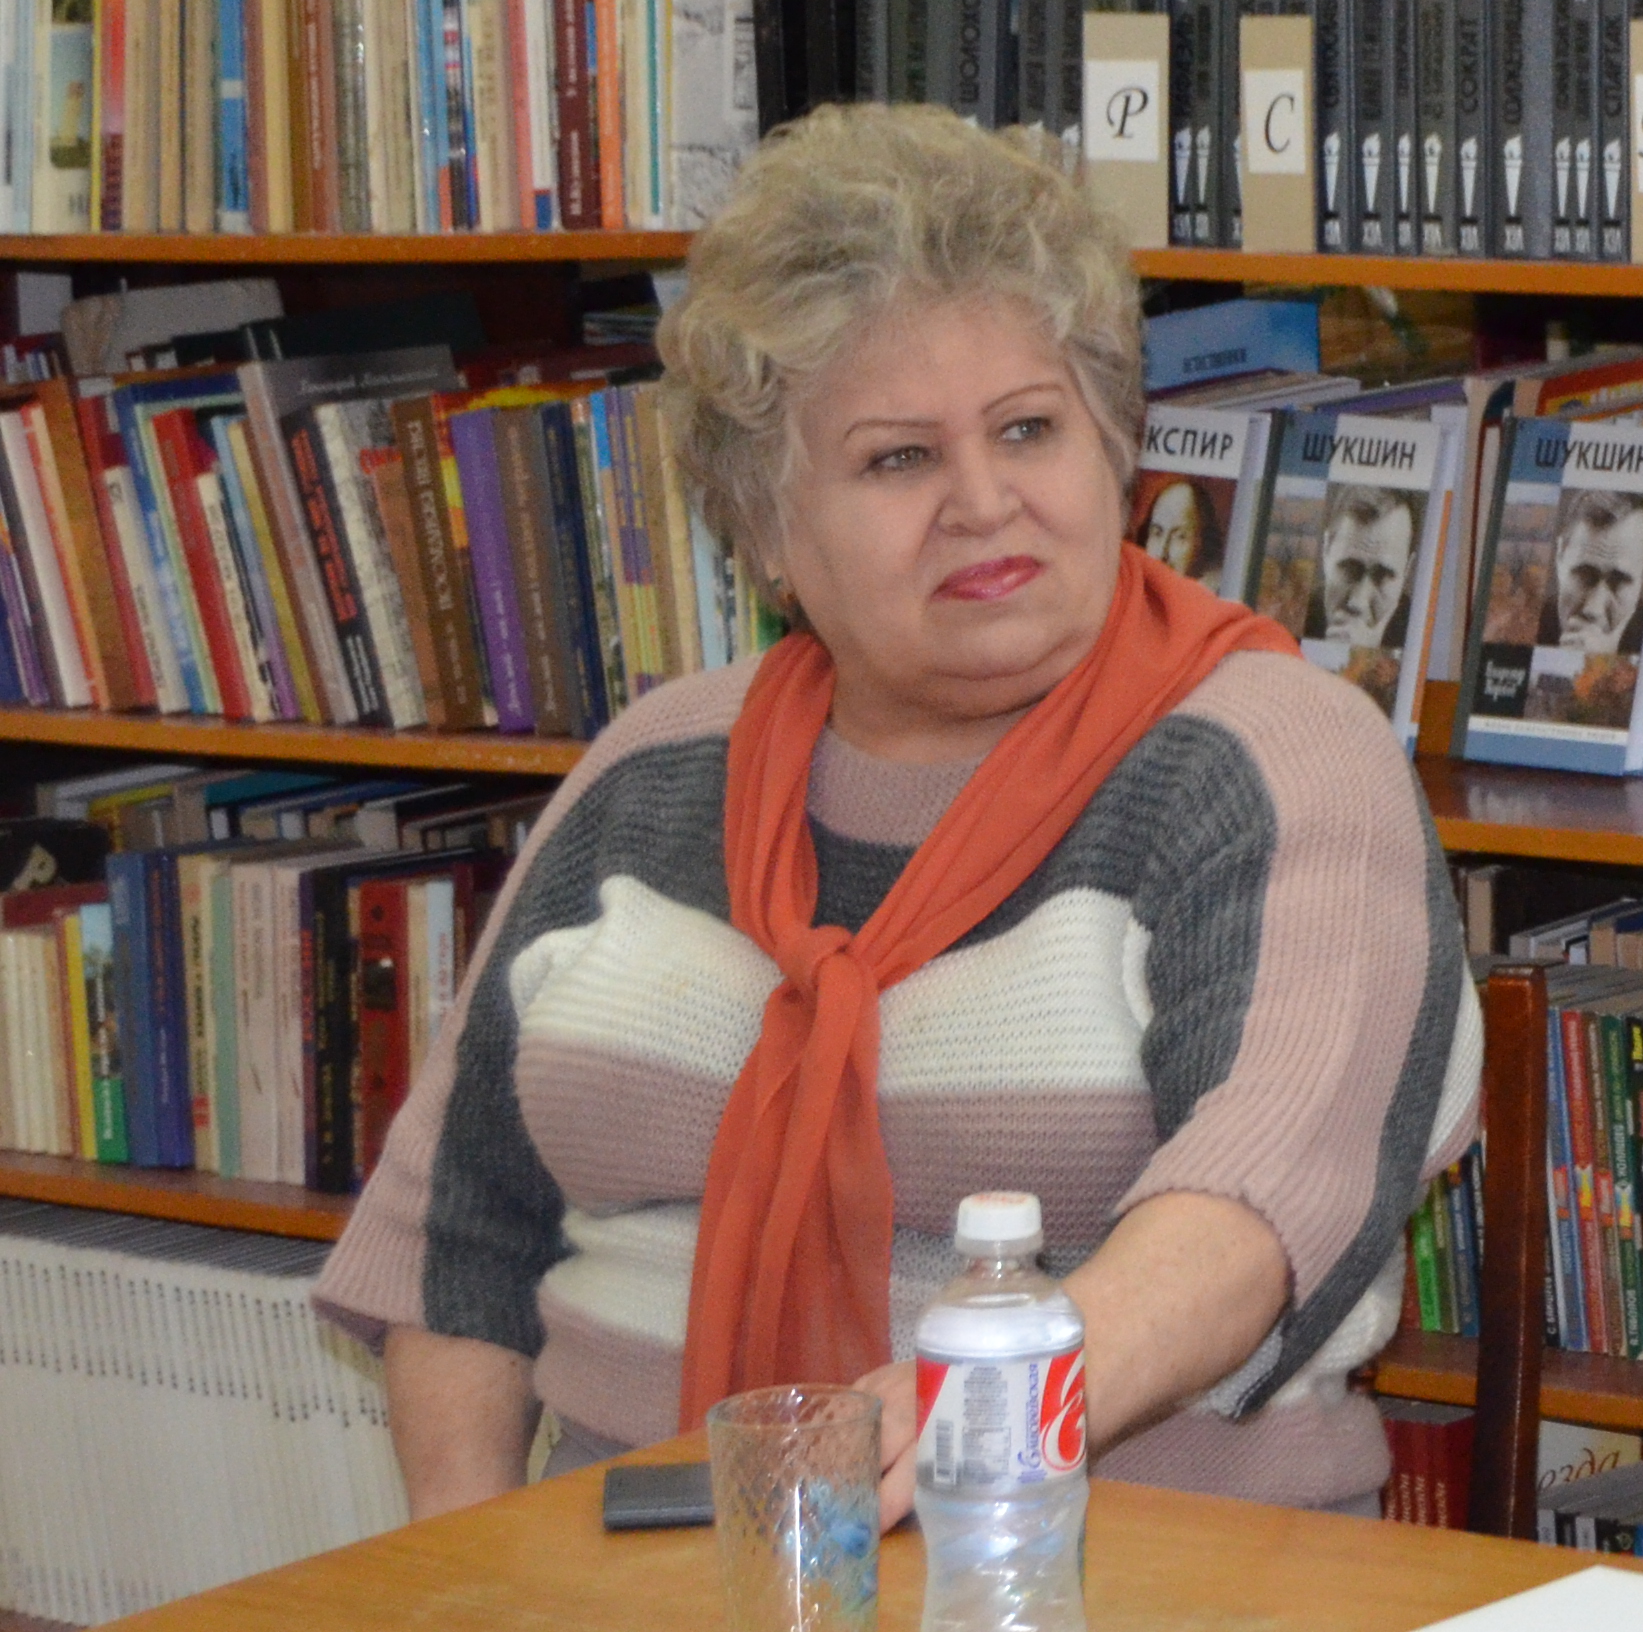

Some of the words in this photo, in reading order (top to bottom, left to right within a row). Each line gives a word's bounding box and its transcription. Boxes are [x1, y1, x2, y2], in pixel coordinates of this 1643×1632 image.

[1459, 17, 1479, 114] СОКРАТ
[1106, 87, 1149, 138] Р
[1265, 94, 1295, 153] С
[1302, 434, 1417, 472] ШУКШИН
